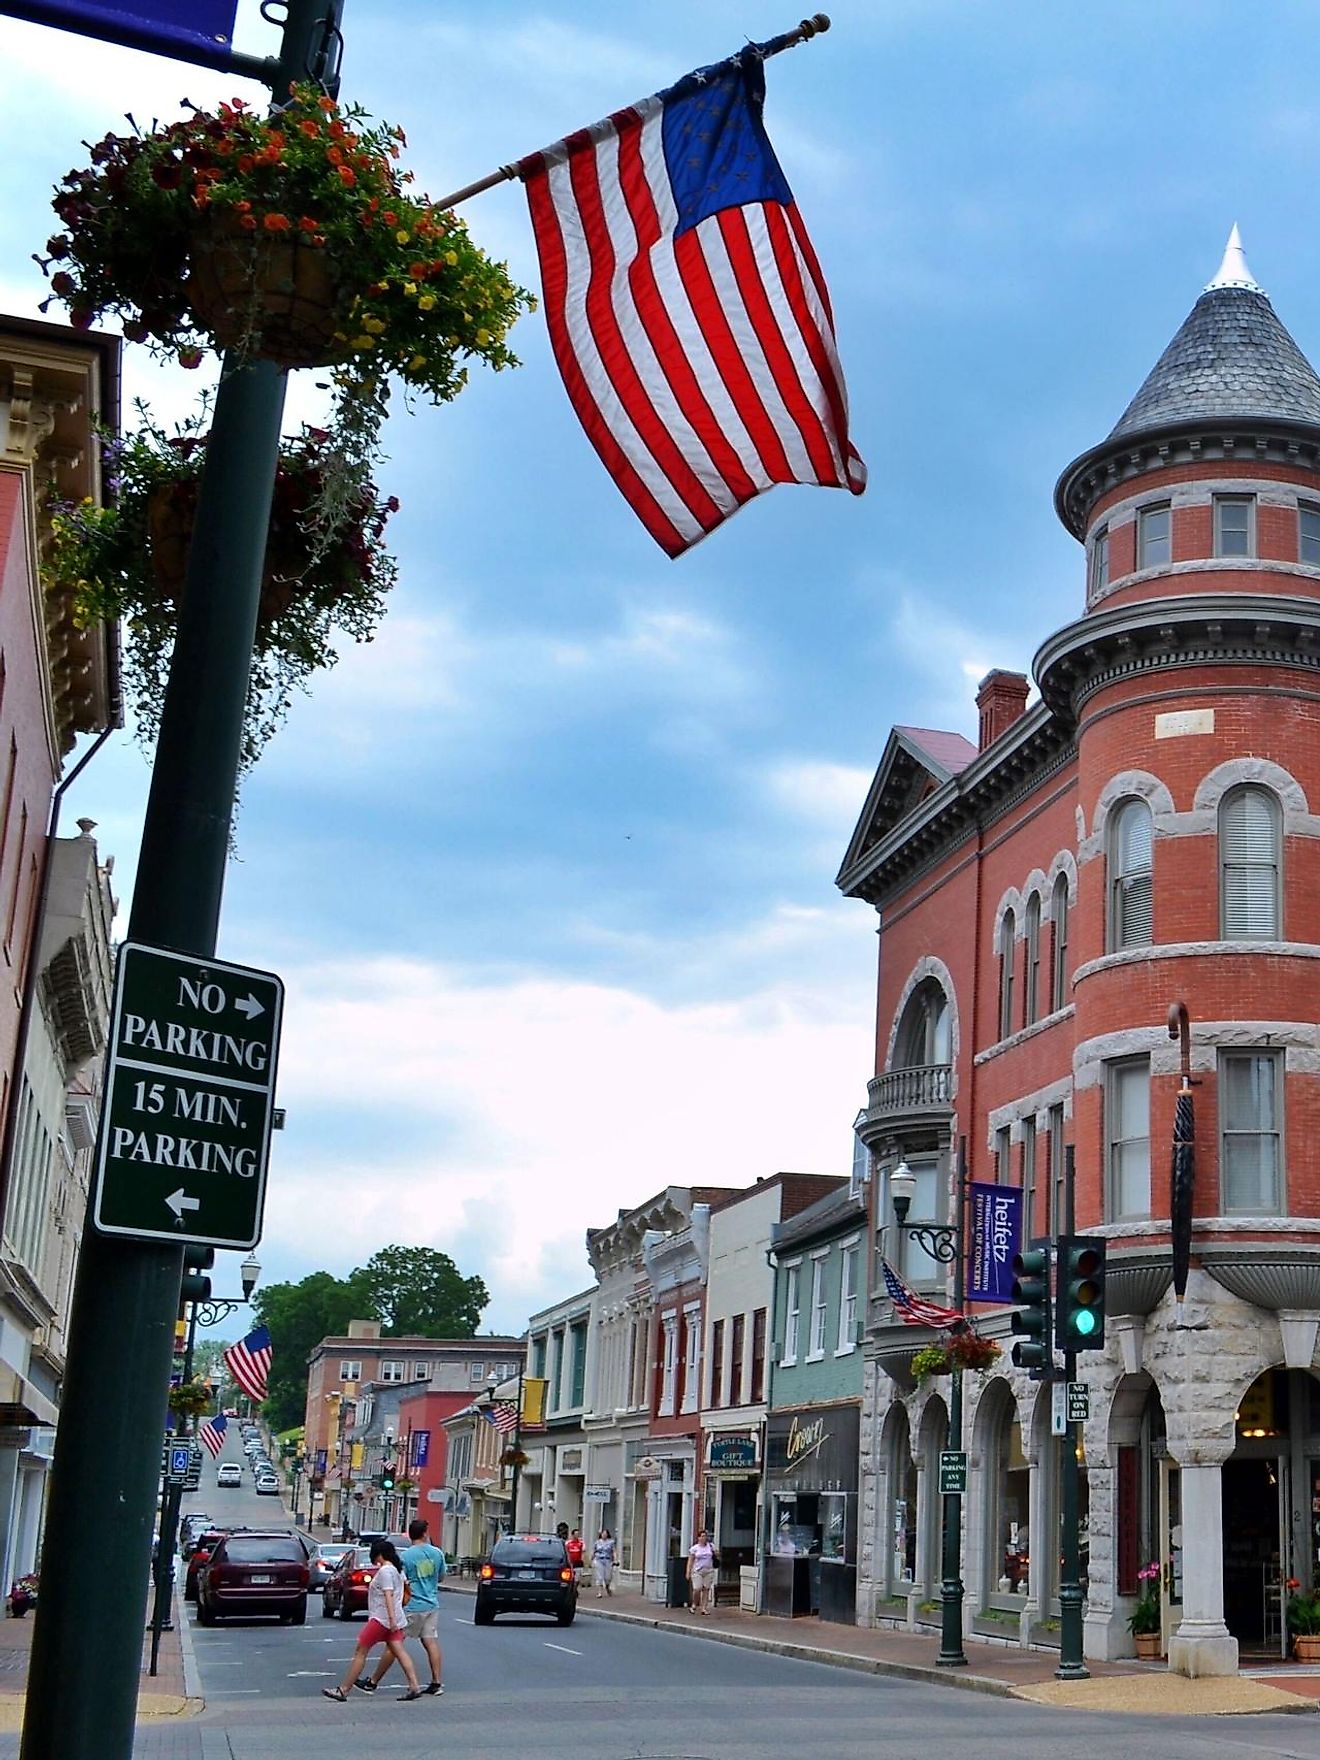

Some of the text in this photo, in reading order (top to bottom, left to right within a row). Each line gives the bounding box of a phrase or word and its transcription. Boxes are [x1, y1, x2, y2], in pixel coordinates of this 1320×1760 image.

[177, 976, 226, 1014] NO
[122, 1014, 268, 1072] PARKING
[132, 1080, 248, 1130] 15 MIN.
[110, 1127, 257, 1178] PARKING
[973, 1193, 984, 1291] FESTIVAL OF CONCERTS
[993, 1196, 1015, 1263] heifetz
[1071, 1410, 1087, 1418] RED
[711, 1459, 753, 1467] BOUTIQUE
